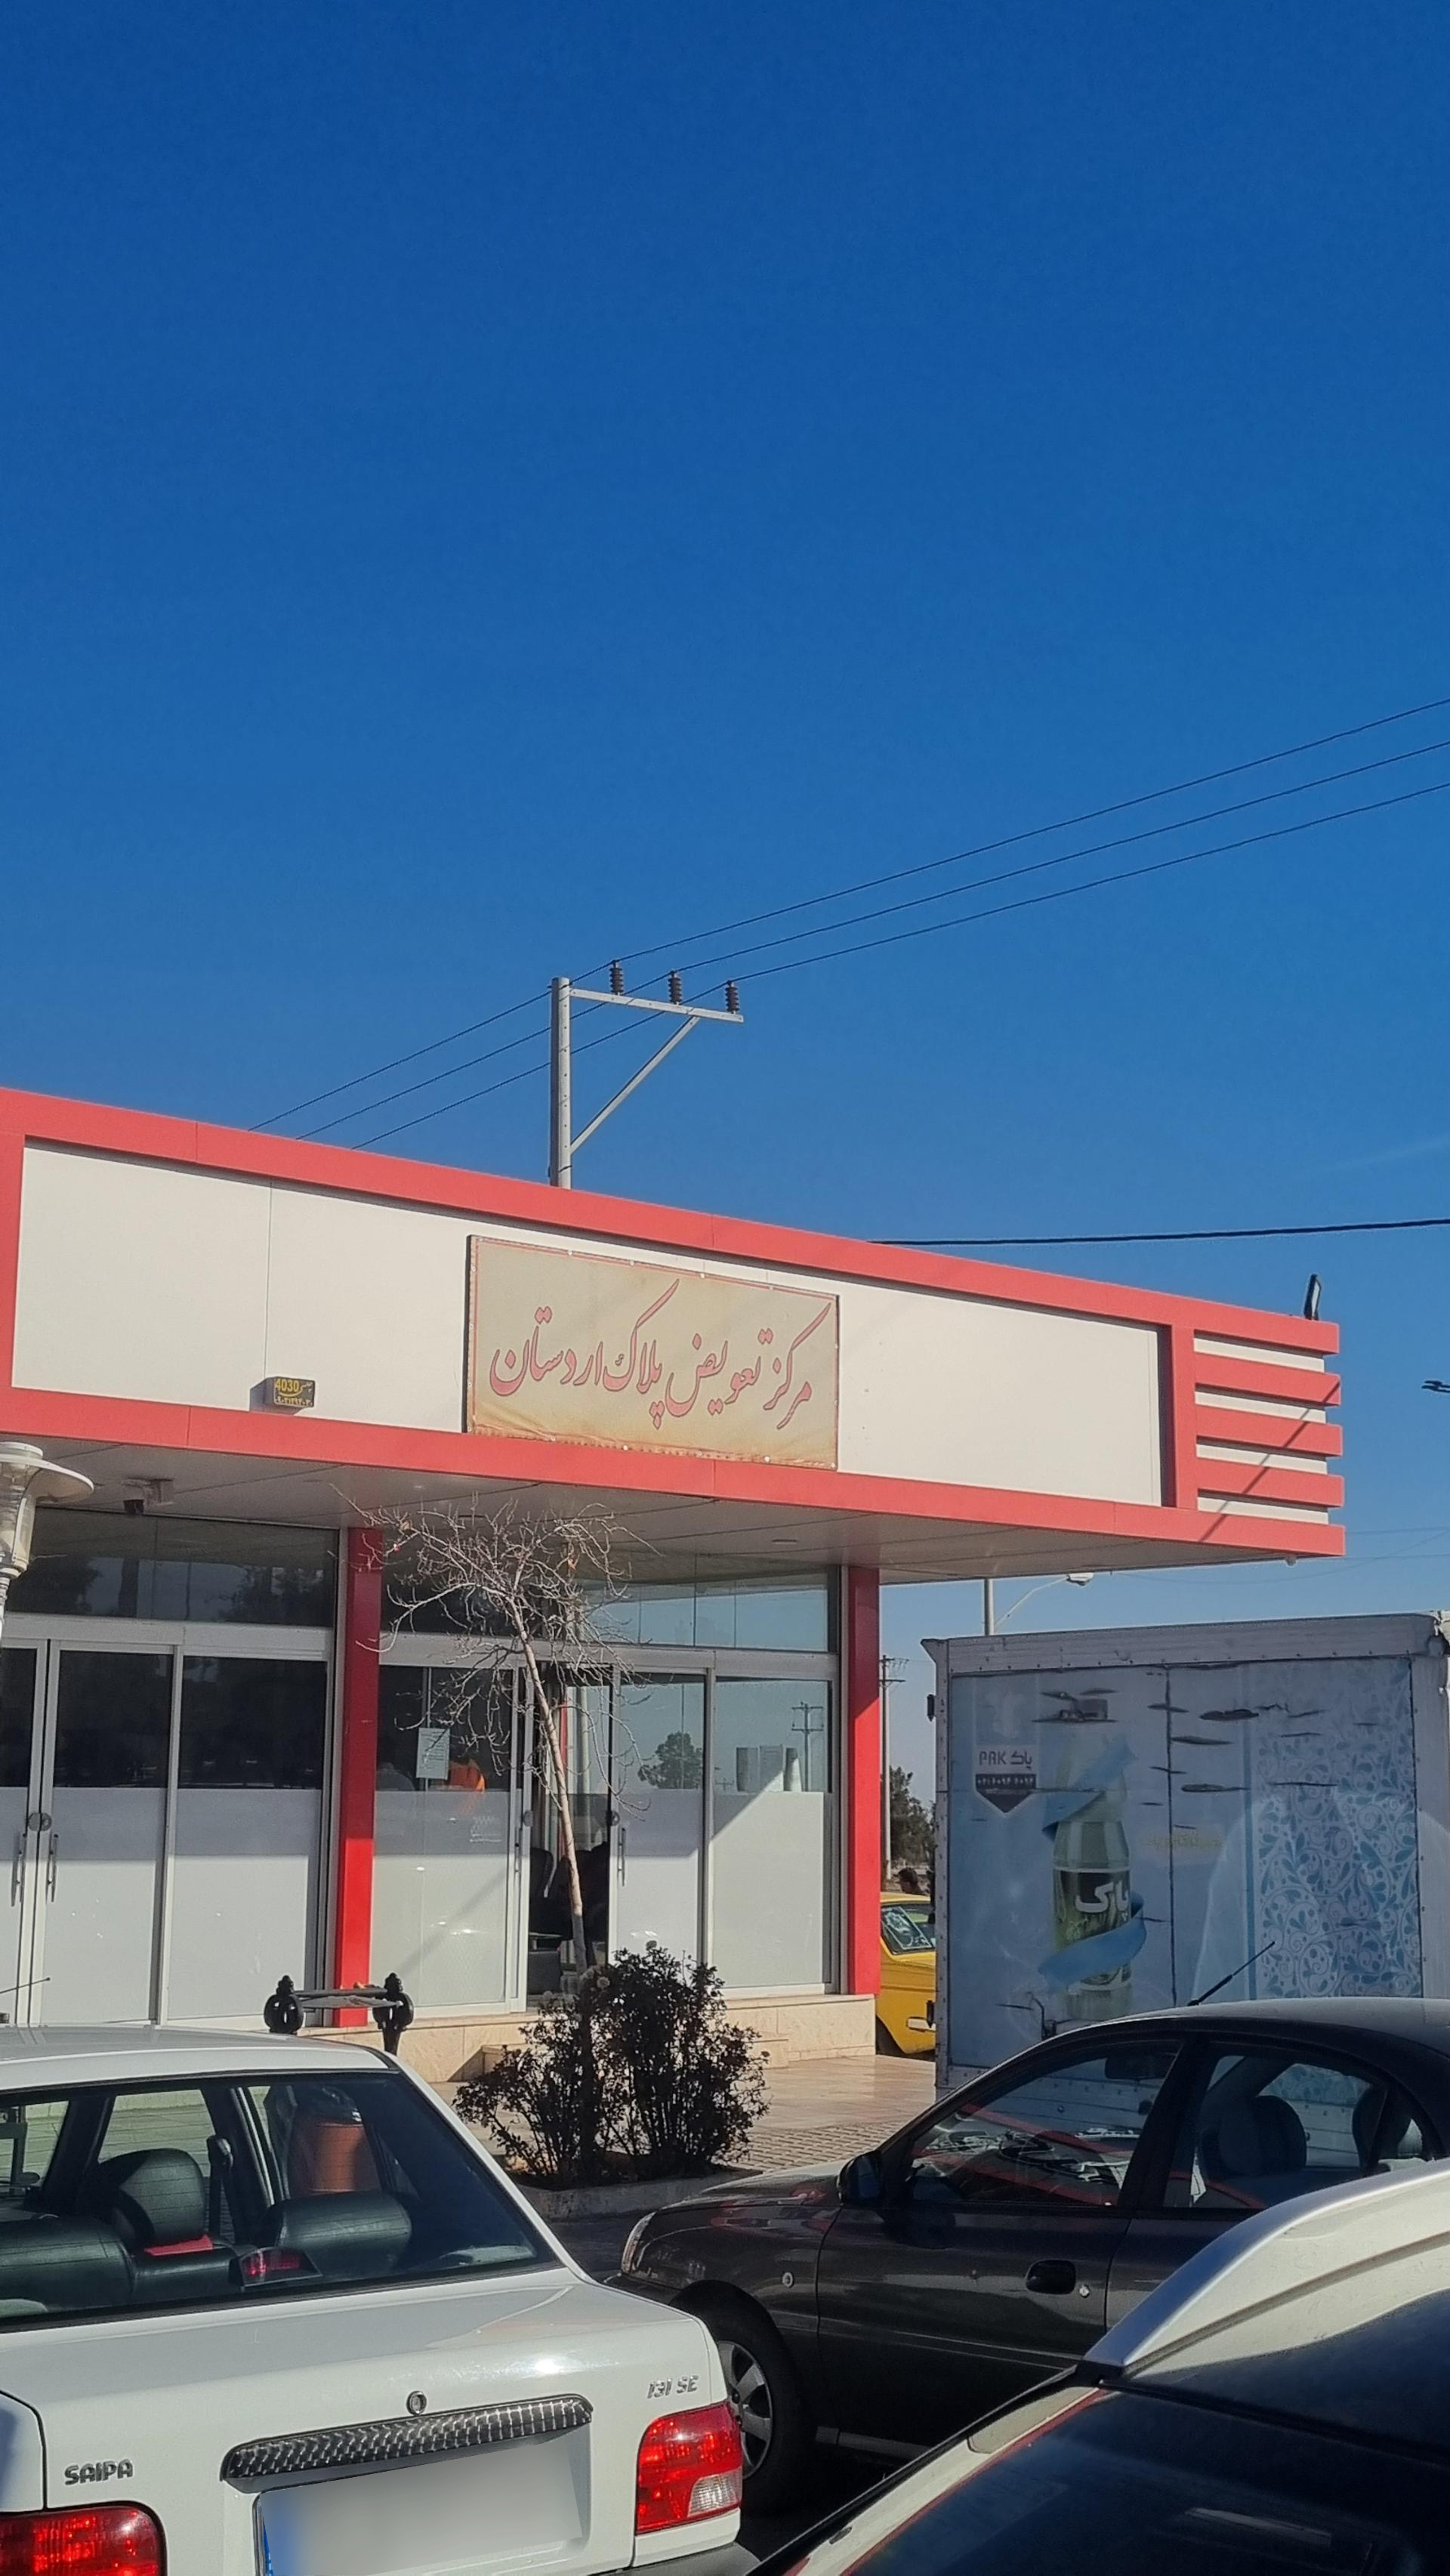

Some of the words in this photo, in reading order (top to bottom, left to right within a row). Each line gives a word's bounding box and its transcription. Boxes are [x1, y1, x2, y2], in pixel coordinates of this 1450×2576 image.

[489, 1305, 603, 1396] اردستان
[603, 1278, 680, 1429] پلاک
[665, 1328, 773, 1417] تعویض
[763, 1303, 831, 1430] مرکز
[275, 1378, 300, 1392] 4030
[979, 1750, 1007, 1765] PAK
[1010, 1749, 1032, 1771] پاک
[647, 2378, 673, 2399] 131
[676, 2374, 699, 2394] SE
[64, 2458, 133, 2485] SAIPA
